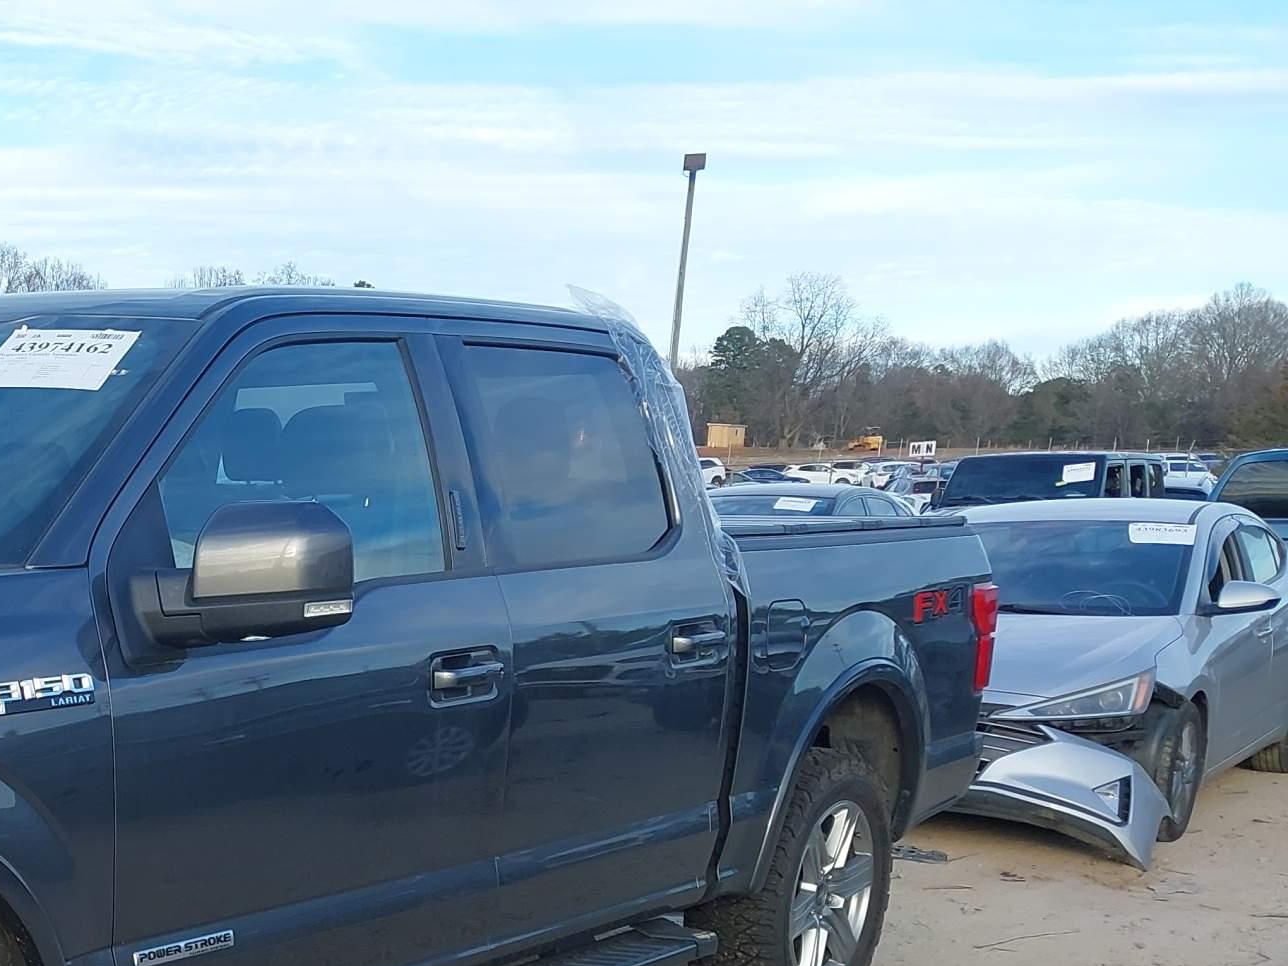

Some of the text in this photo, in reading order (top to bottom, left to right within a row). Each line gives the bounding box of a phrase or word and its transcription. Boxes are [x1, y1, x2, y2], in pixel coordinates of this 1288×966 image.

[11, 342, 113, 354] 43974162
[911, 443, 933, 454] M N
[913, 583, 966, 624] FX4
[51, 694, 91, 706] LARIAT
[138, 945, 182, 963] POWER
[184, 932, 232, 952] STROKE
